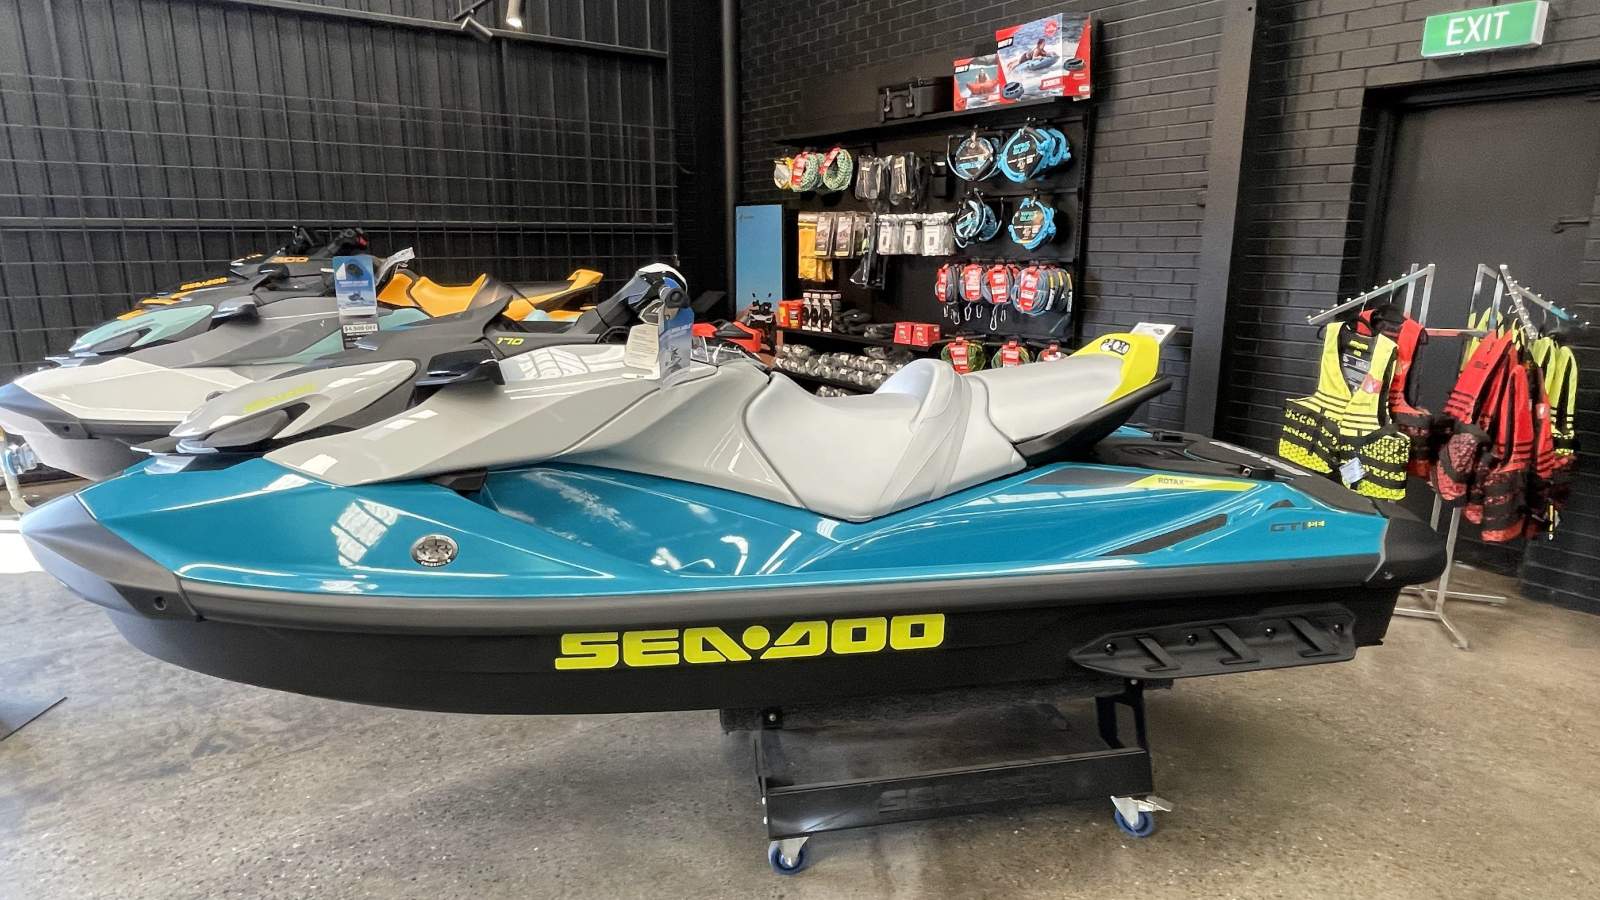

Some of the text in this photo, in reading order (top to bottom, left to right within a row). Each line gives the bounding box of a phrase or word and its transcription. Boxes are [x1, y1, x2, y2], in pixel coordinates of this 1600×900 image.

[1446, 11, 1510, 46] EXIT
[497, 337, 525, 345] 170
[1157, 477, 1185, 486] ROTAX
[1270, 522, 1306, 531] GTI
